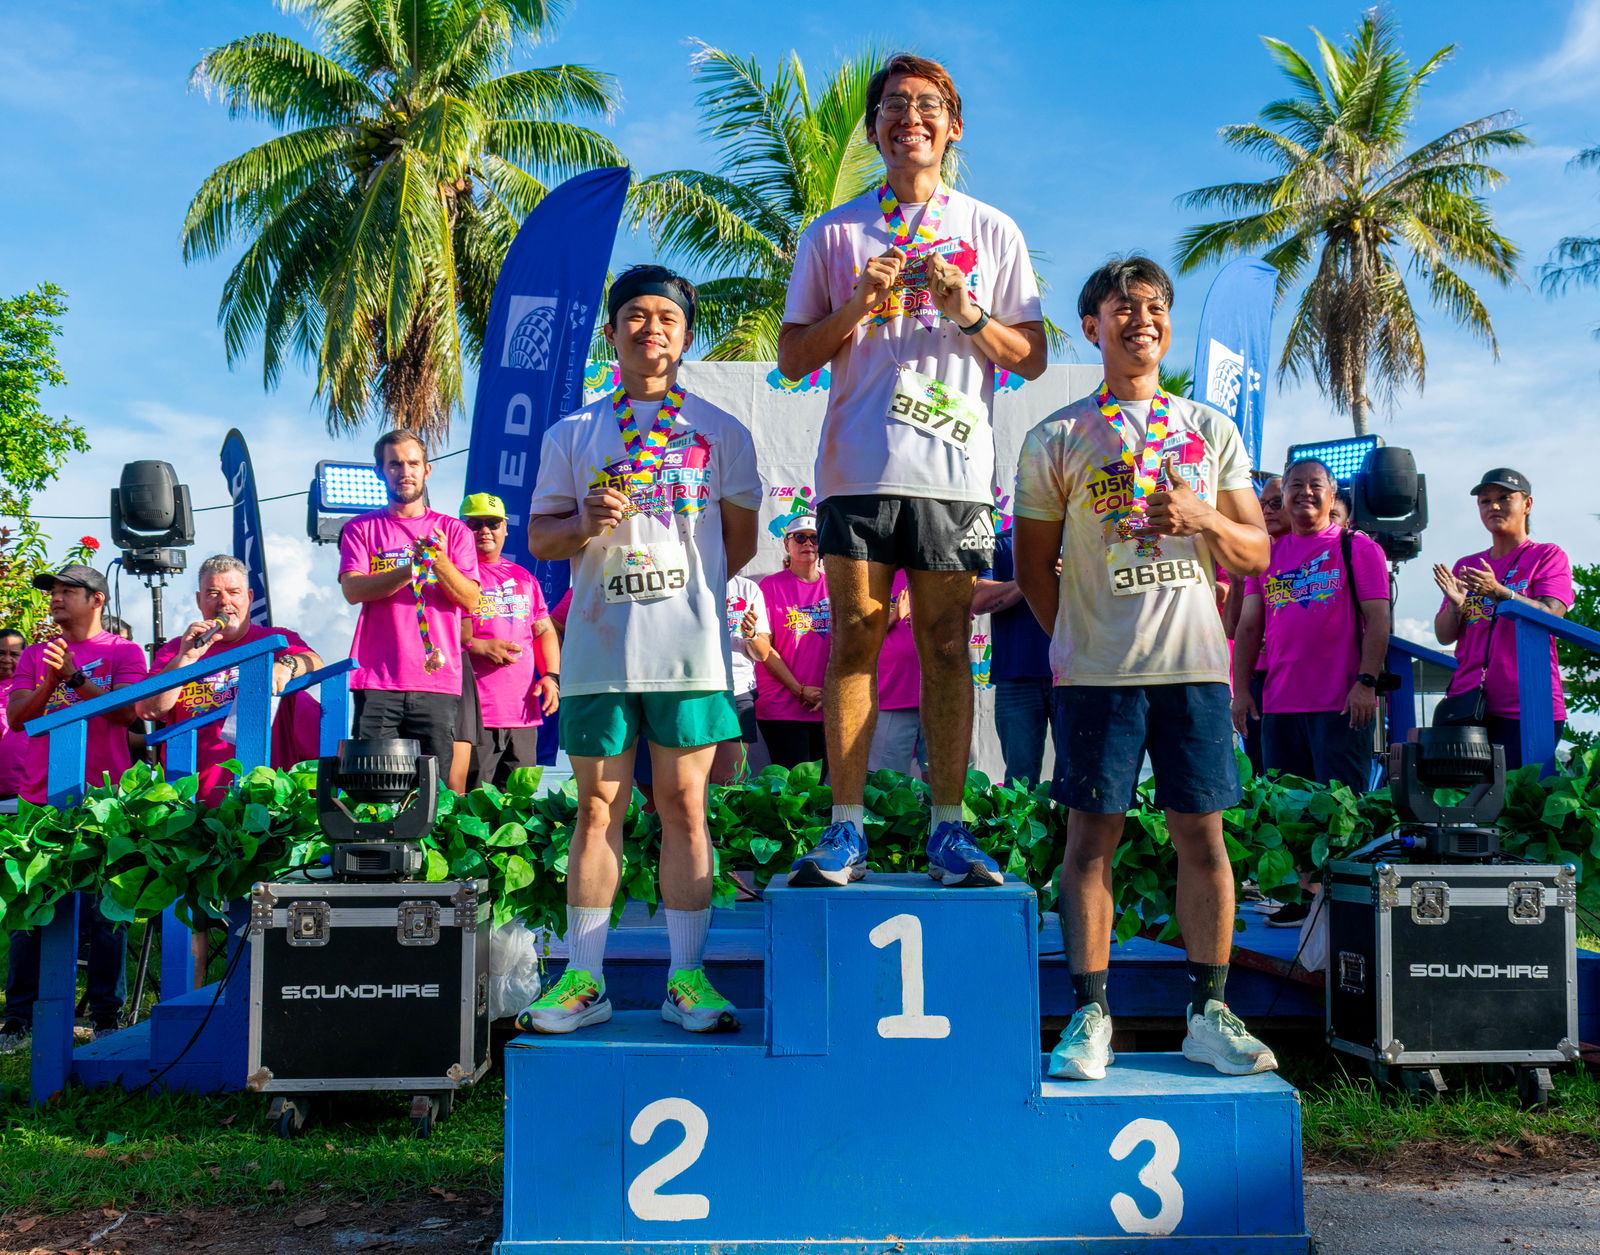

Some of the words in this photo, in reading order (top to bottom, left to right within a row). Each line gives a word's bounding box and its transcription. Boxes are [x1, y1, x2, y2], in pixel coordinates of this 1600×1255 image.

[911, 308, 938, 318] SAIPAN
[558, 340, 577, 419] EMBER
[891, 393, 971, 444] 3578
[652, 469, 711, 485] UBBLE
[1087, 475, 1134, 498] TJ5K
[672, 485, 711, 501] RUN
[1094, 493, 1133, 514] COL
[608, 568, 685, 596] 4003
[1114, 559, 1195, 590] 3688
[1310, 577, 1340, 594] RUN
[970, 634, 988, 645] 5K
[183, 684, 214, 697] TJ5K
[183, 690, 233, 707] COLOR
[869, 913, 951, 1039] 1
[1409, 963, 1549, 979] SOUNDHIRE
[281, 983, 440, 1000] SOUNDHIRE
[627, 1096, 710, 1221] 2
[1108, 1117, 1184, 1236] 3
